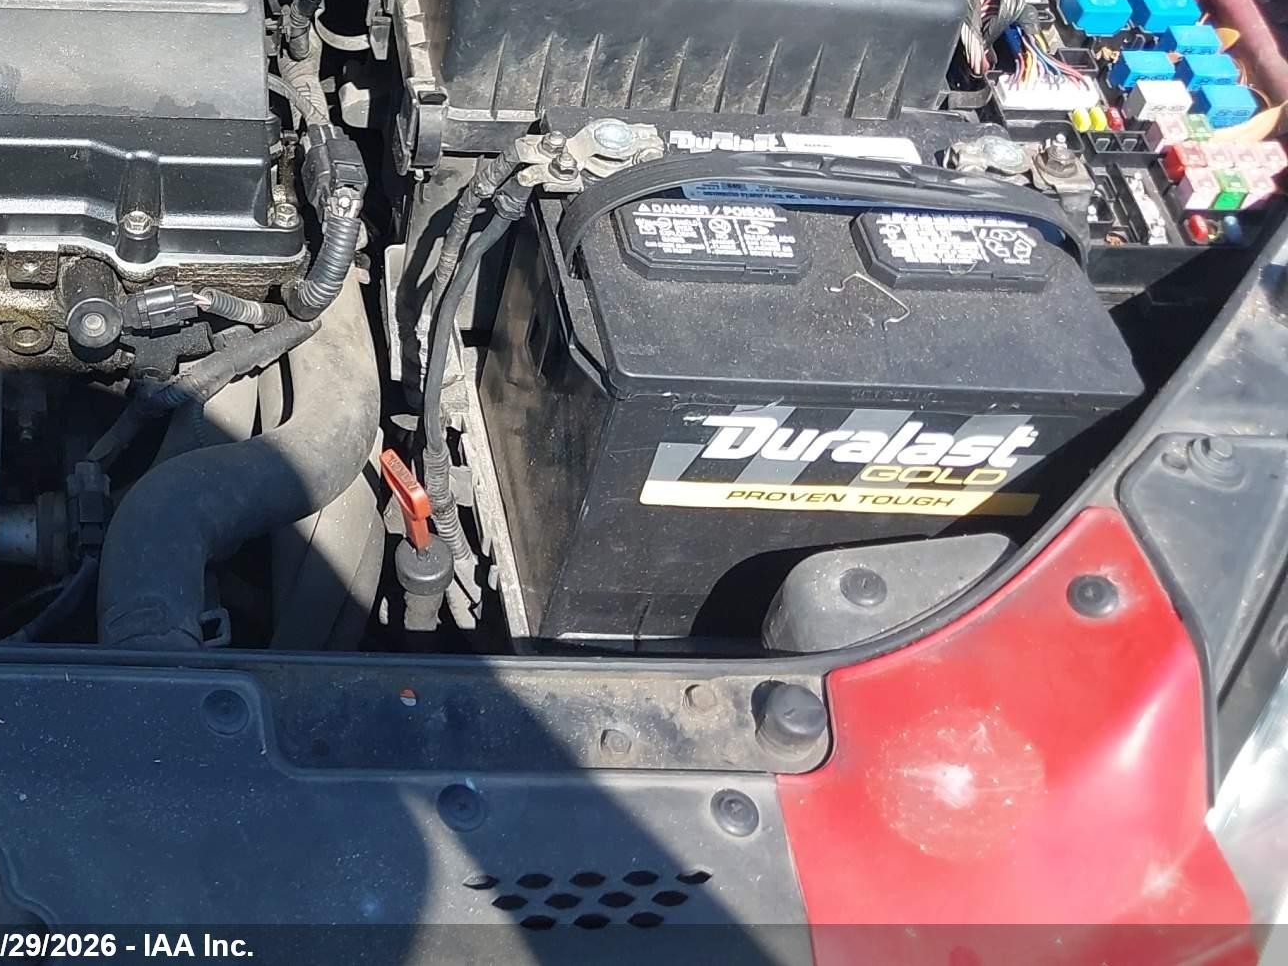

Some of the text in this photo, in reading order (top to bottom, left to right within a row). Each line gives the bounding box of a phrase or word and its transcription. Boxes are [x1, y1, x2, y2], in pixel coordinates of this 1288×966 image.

[651, 204, 709, 215] DANGER
[723, 206, 776, 218] POISON
[701, 415, 1040, 468] Duralast
[859, 465, 1009, 486] GOLD
[726, 489, 958, 508] PROVEN TOUGH
